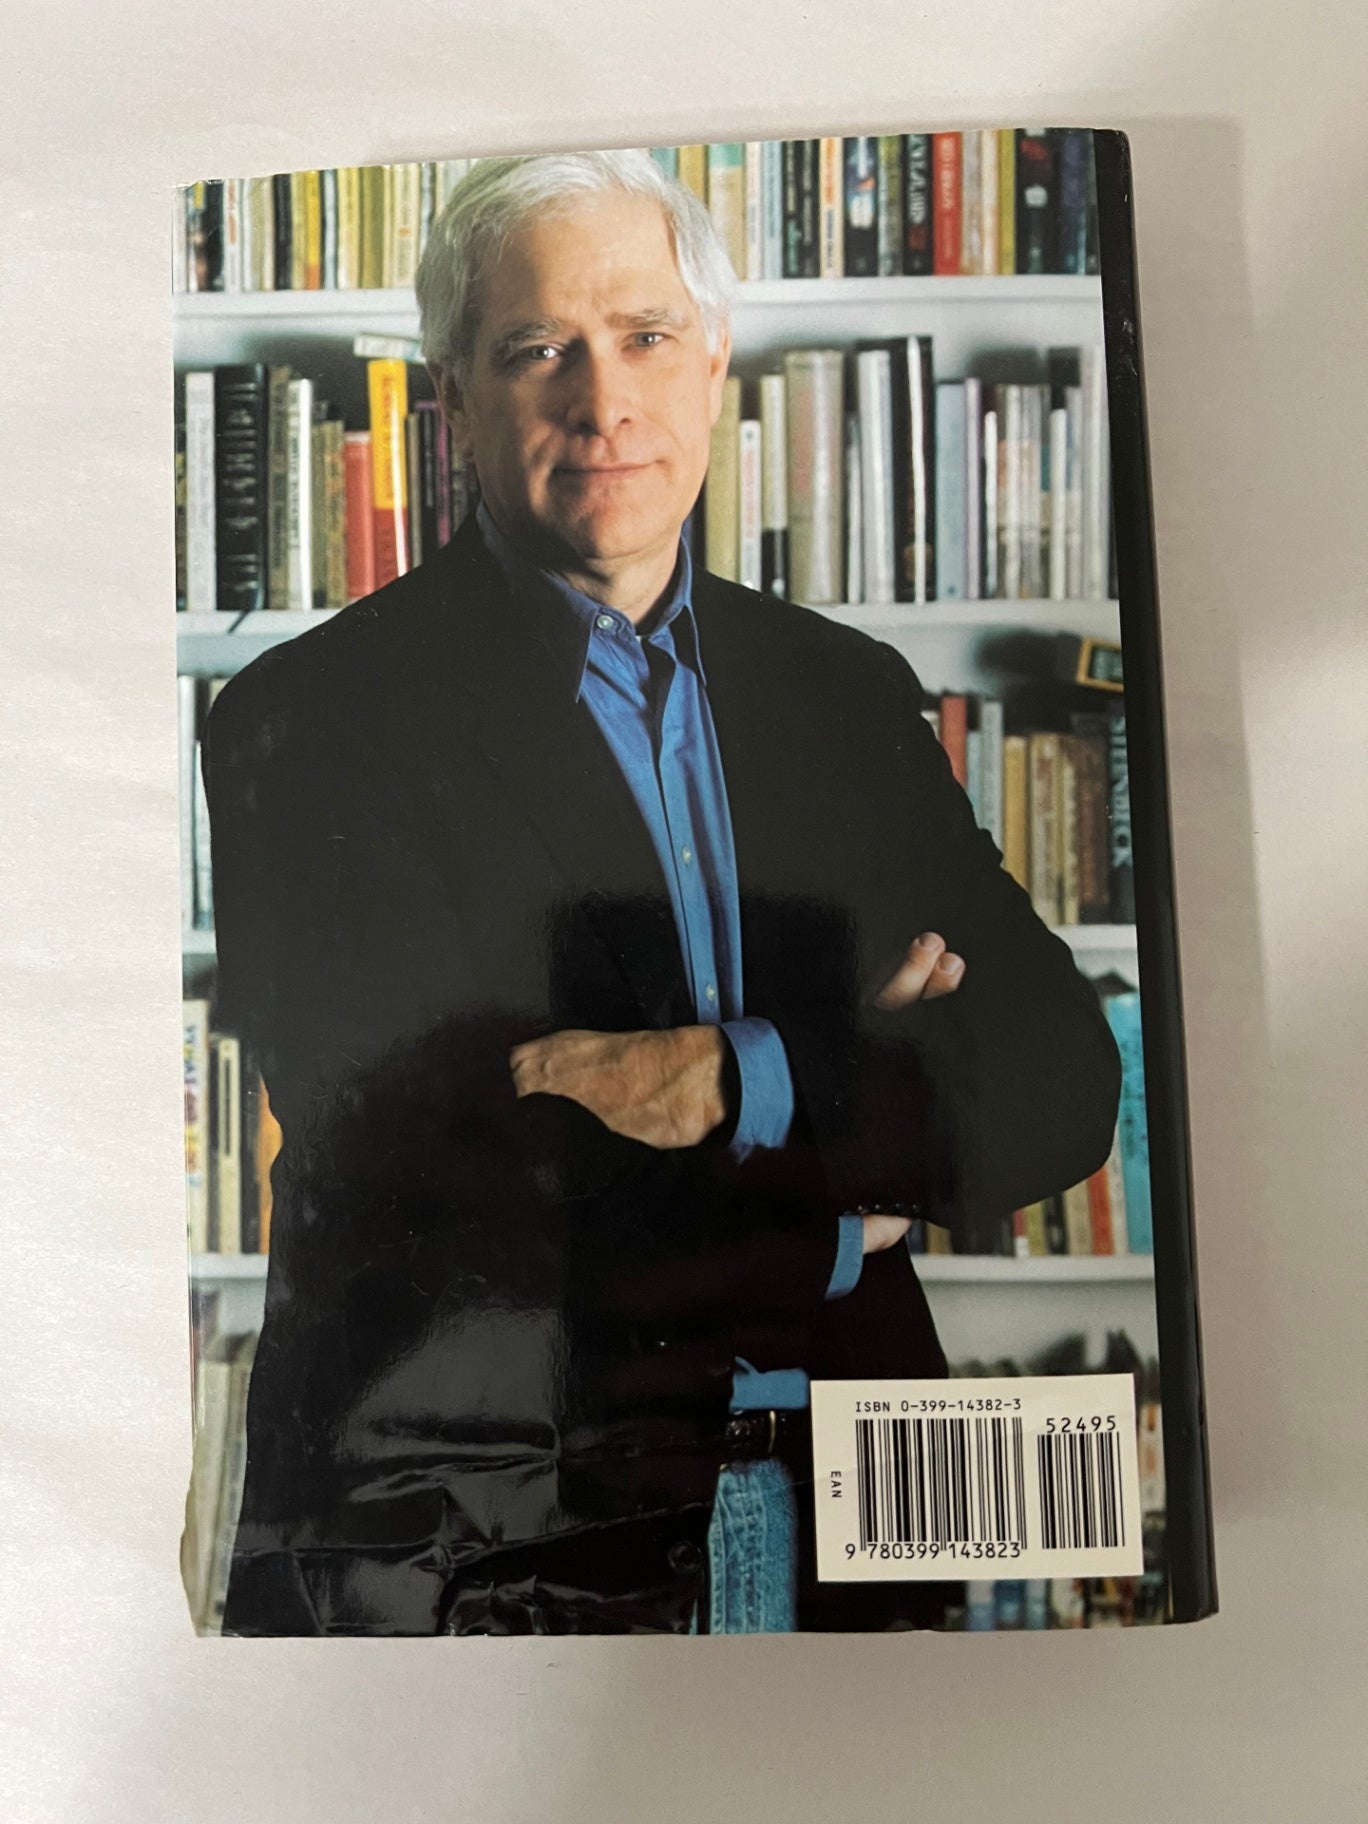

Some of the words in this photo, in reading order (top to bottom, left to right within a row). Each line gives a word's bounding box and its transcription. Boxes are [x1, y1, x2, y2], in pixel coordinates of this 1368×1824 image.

[855, 1401, 891, 1413] ISBN
[900, 1398, 1022, 1413] 0-399-14382-3
[1046, 1415, 1116, 1433] 52495
[830, 1470, 842, 1498] EAN
[845, 1543, 856, 1560] 9
[867, 1543, 940, 1560] 780399
[948, 1541, 1021, 1559] 143823
